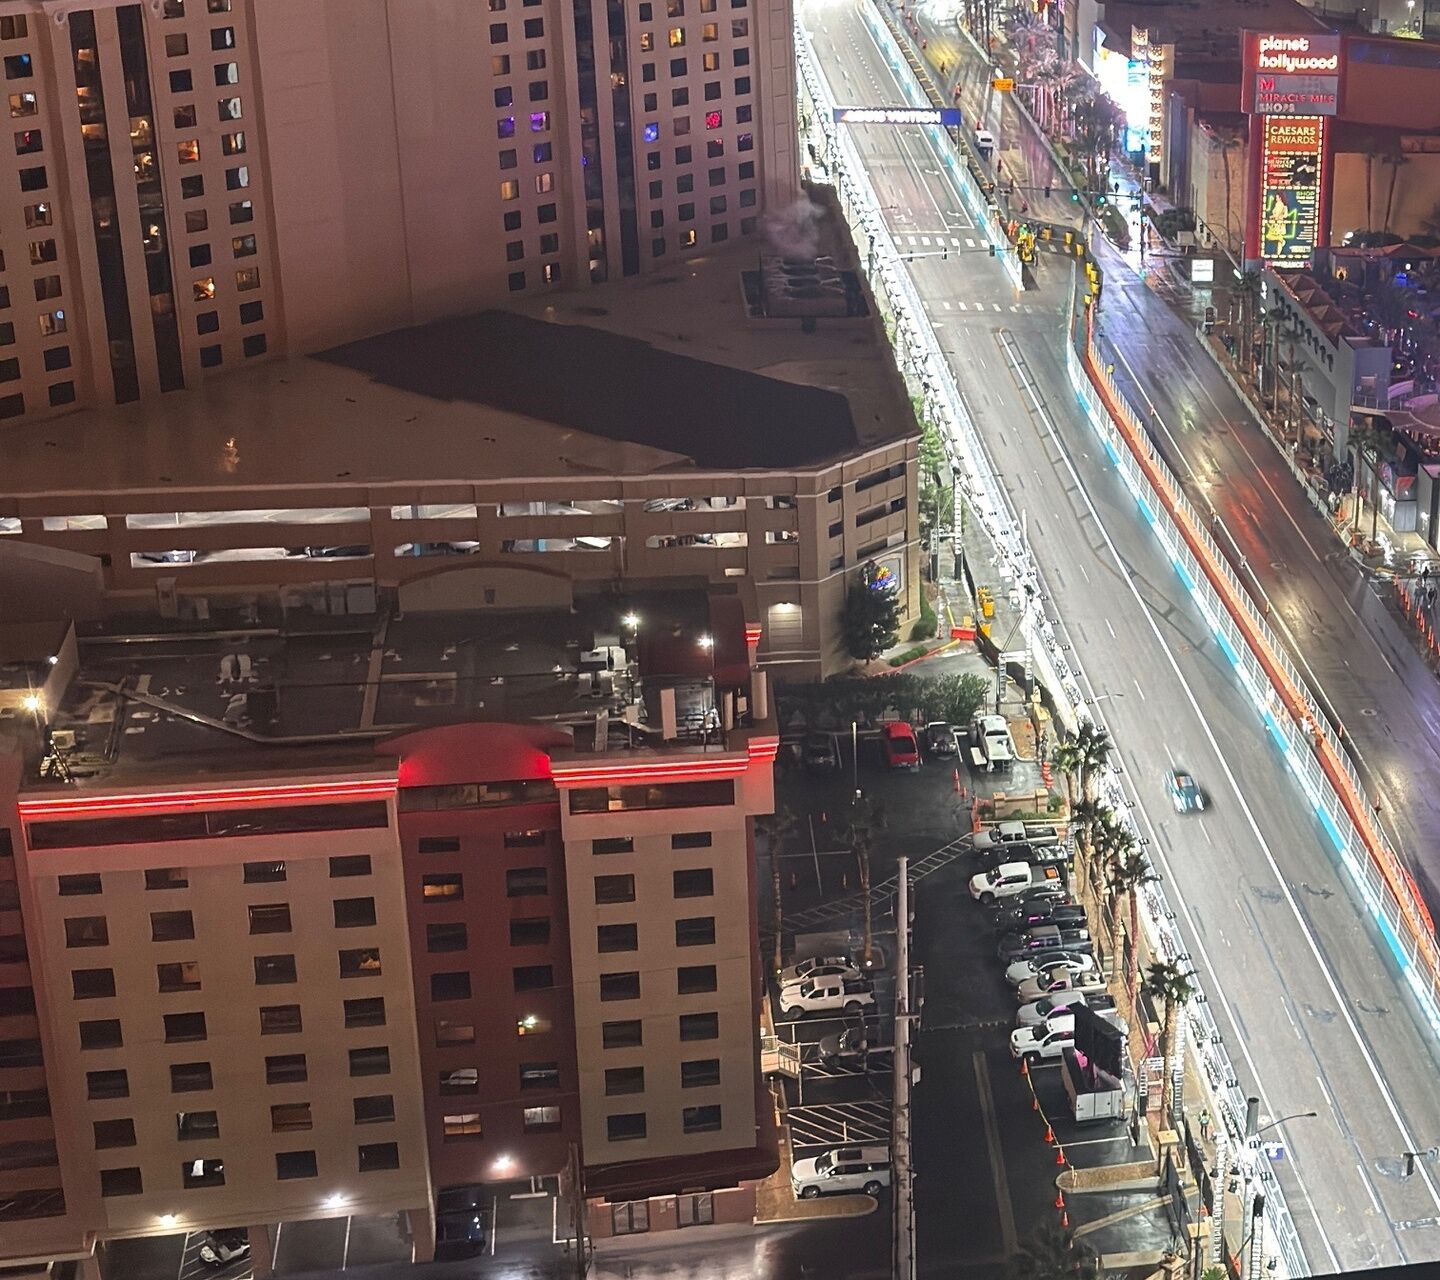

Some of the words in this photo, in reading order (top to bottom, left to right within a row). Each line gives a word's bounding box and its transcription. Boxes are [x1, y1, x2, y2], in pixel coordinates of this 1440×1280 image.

[1260, 35, 1309, 52] planet
[1260, 54, 1337, 72] hollywood
[1260, 93, 1306, 102] MIRACLE
[1310, 95, 1334, 103] MILE
[1259, 103, 1295, 112] SHOPS
[1271, 126, 1316, 135] CAESARS
